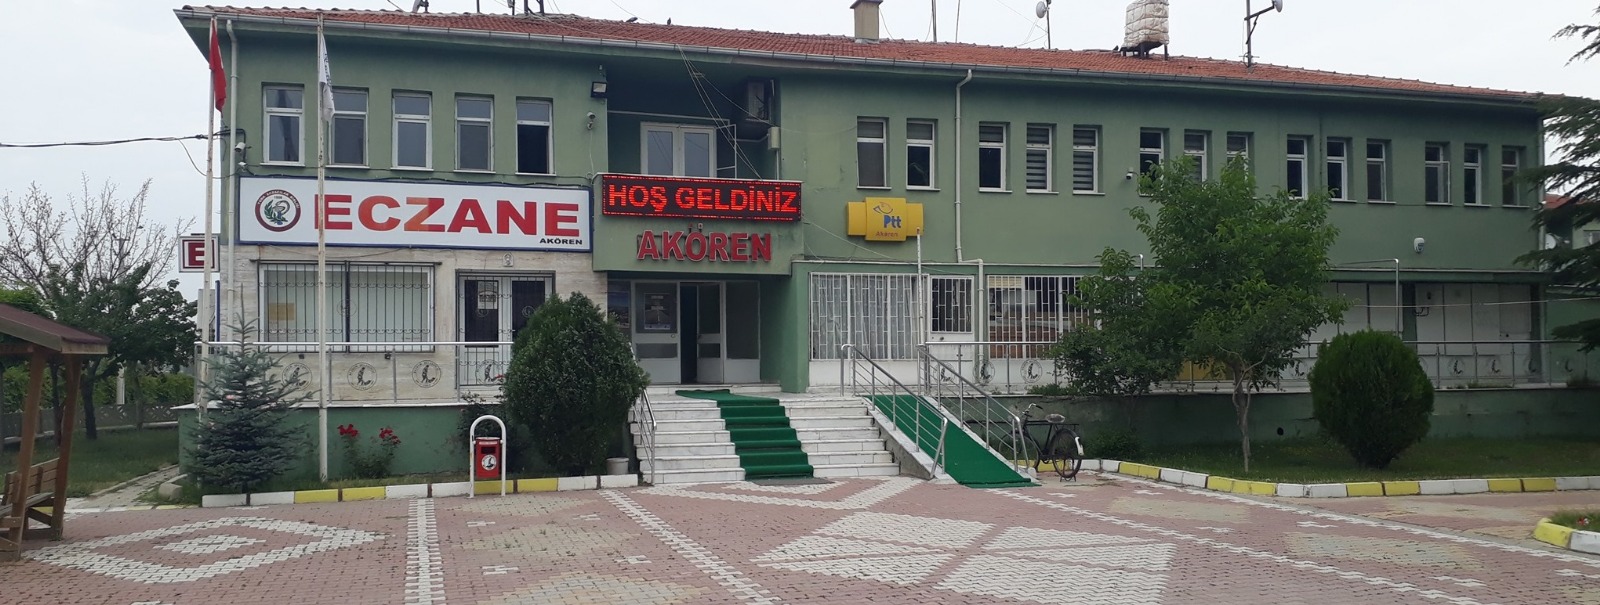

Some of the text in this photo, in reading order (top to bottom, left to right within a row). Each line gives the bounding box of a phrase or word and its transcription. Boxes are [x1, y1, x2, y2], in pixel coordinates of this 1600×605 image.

[608, 184, 798, 213] HOŞ GELDİNİZ
[314, 194, 580, 238] ECZANE
[883, 214, 902, 228] Ptt
[188, 242, 206, 266] E
[540, 237, 583, 245] AKÖREN
[637, 223, 773, 262] AKÖREN
